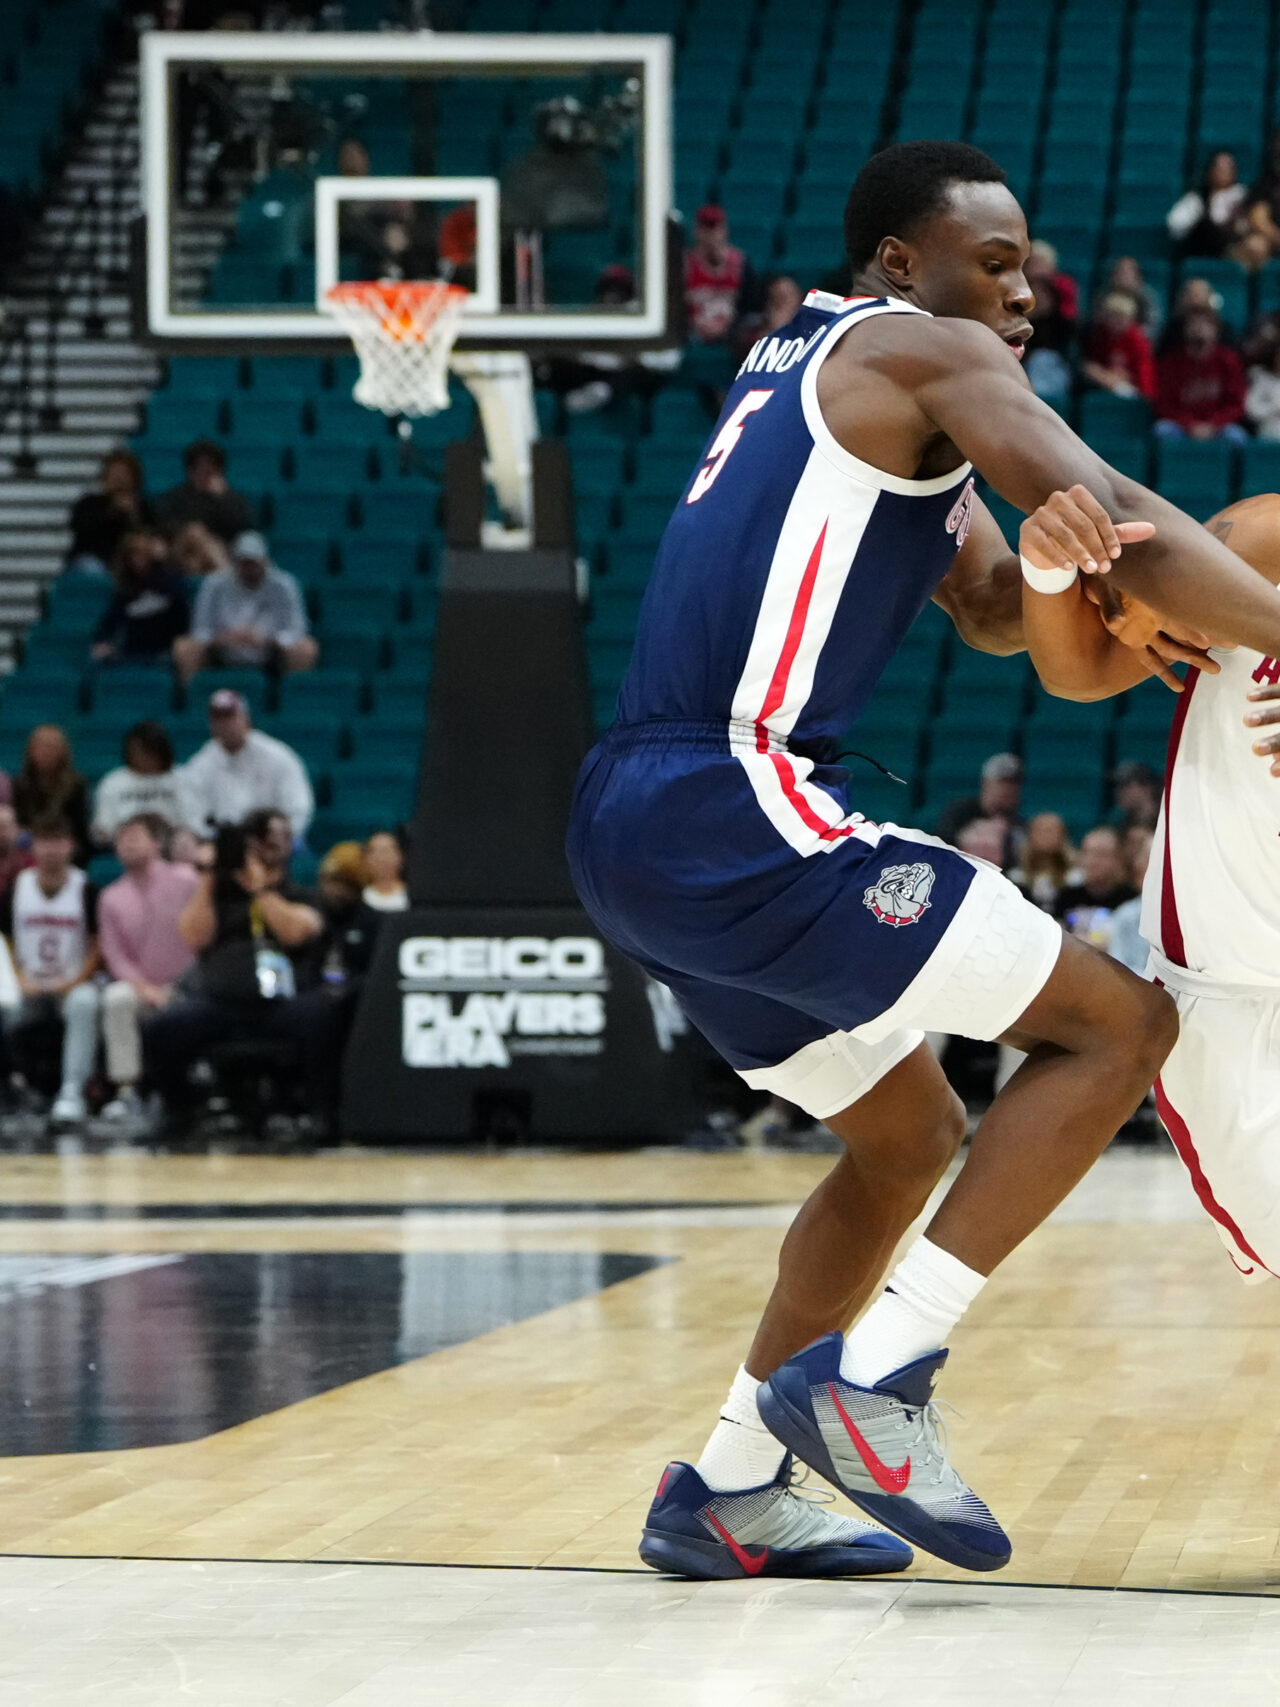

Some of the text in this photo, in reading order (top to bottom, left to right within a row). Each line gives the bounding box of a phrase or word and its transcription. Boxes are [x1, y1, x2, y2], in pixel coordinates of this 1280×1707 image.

[685, 388, 776, 506] 5
[399, 936, 604, 978] GEICO
[402, 992, 607, 1034] PLAYERS
[402, 1032, 511, 1068] ERA
